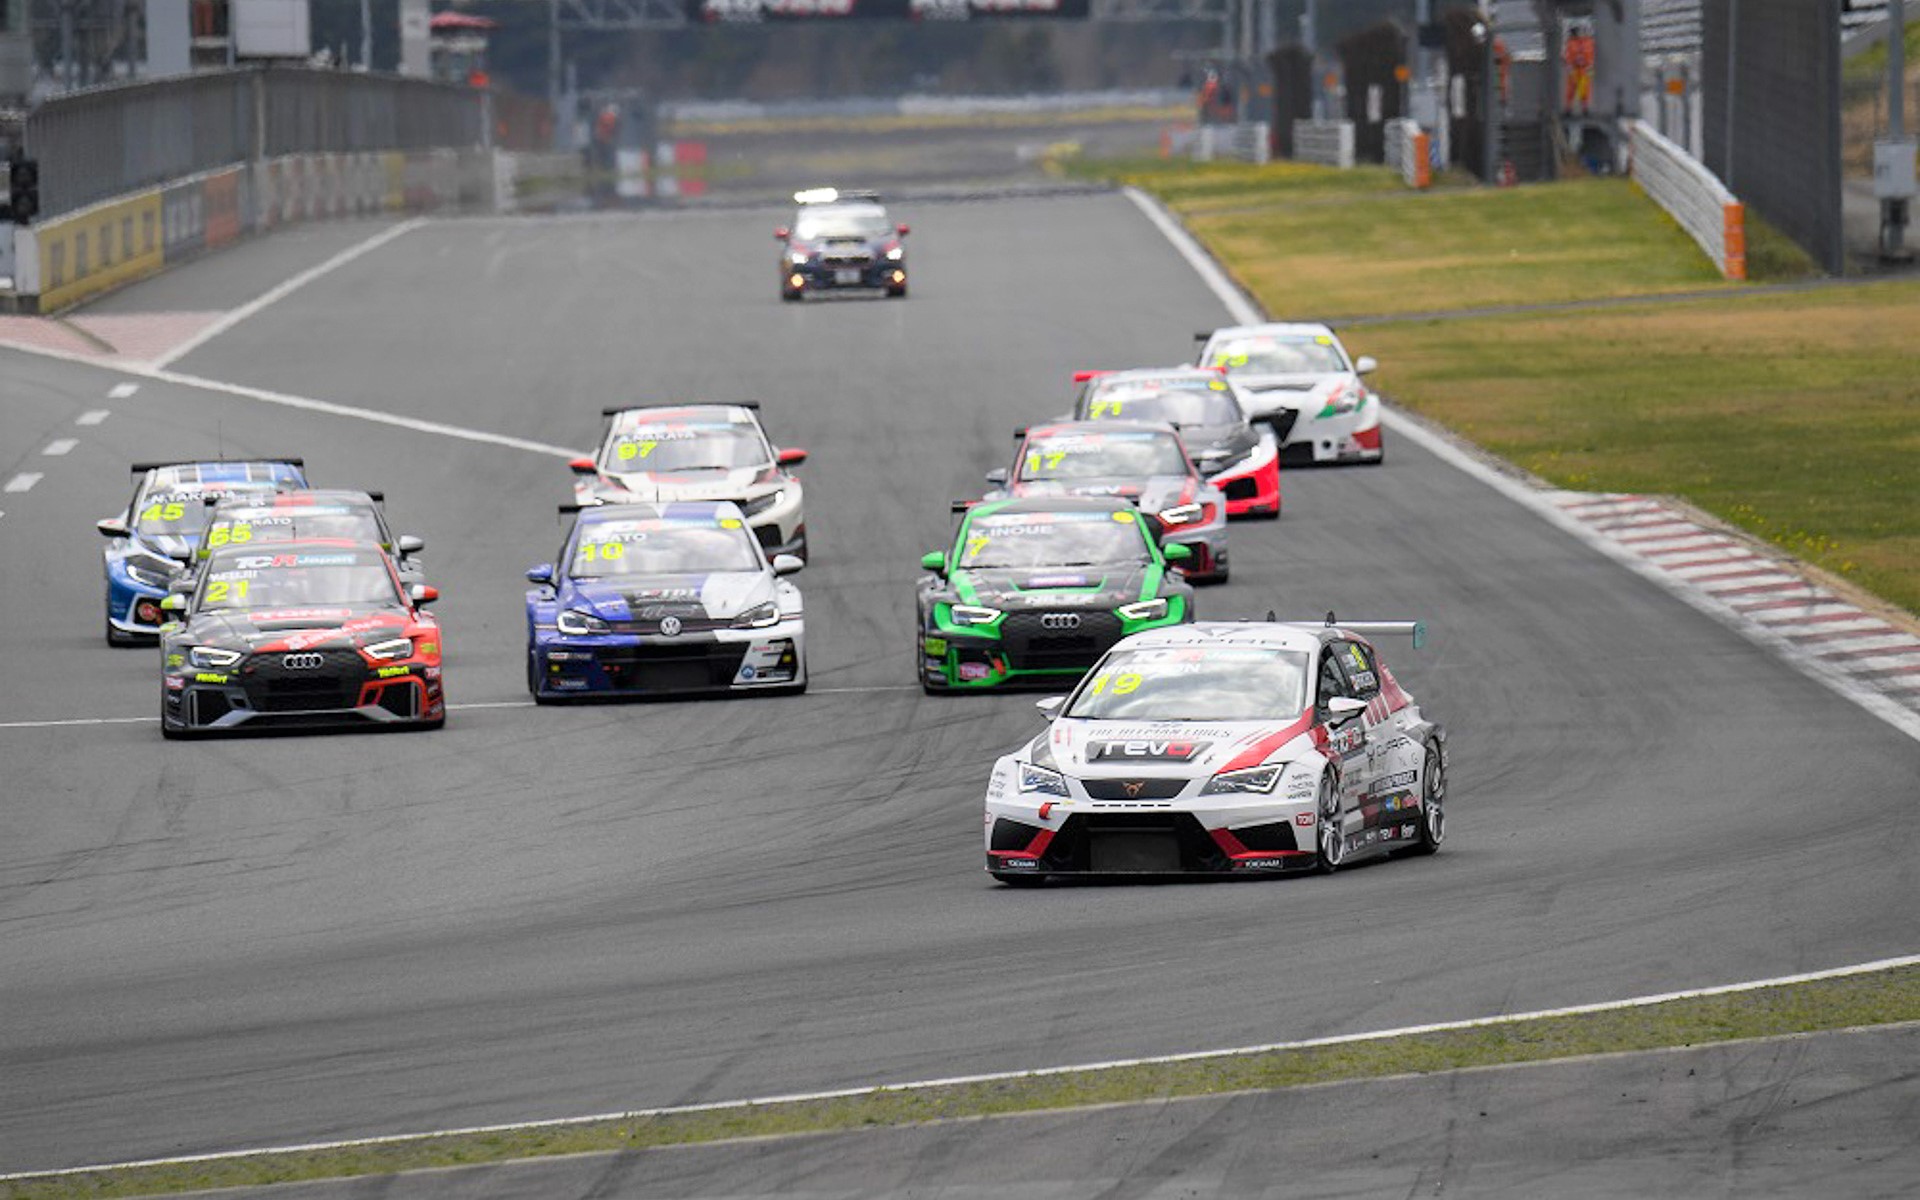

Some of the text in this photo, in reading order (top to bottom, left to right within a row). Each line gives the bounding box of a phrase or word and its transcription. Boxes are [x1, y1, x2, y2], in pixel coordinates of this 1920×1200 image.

[618, 439, 658, 461] 97
[1027, 451, 1066, 472] 17
[141, 502, 185, 521] 45
[208, 523, 252, 546] 65
[581, 542, 624, 563] 10
[967, 535, 990, 557] 7
[235, 554, 299, 569] TCR
[205, 579, 249, 602] 21
[1089, 672, 1144, 696] 19
